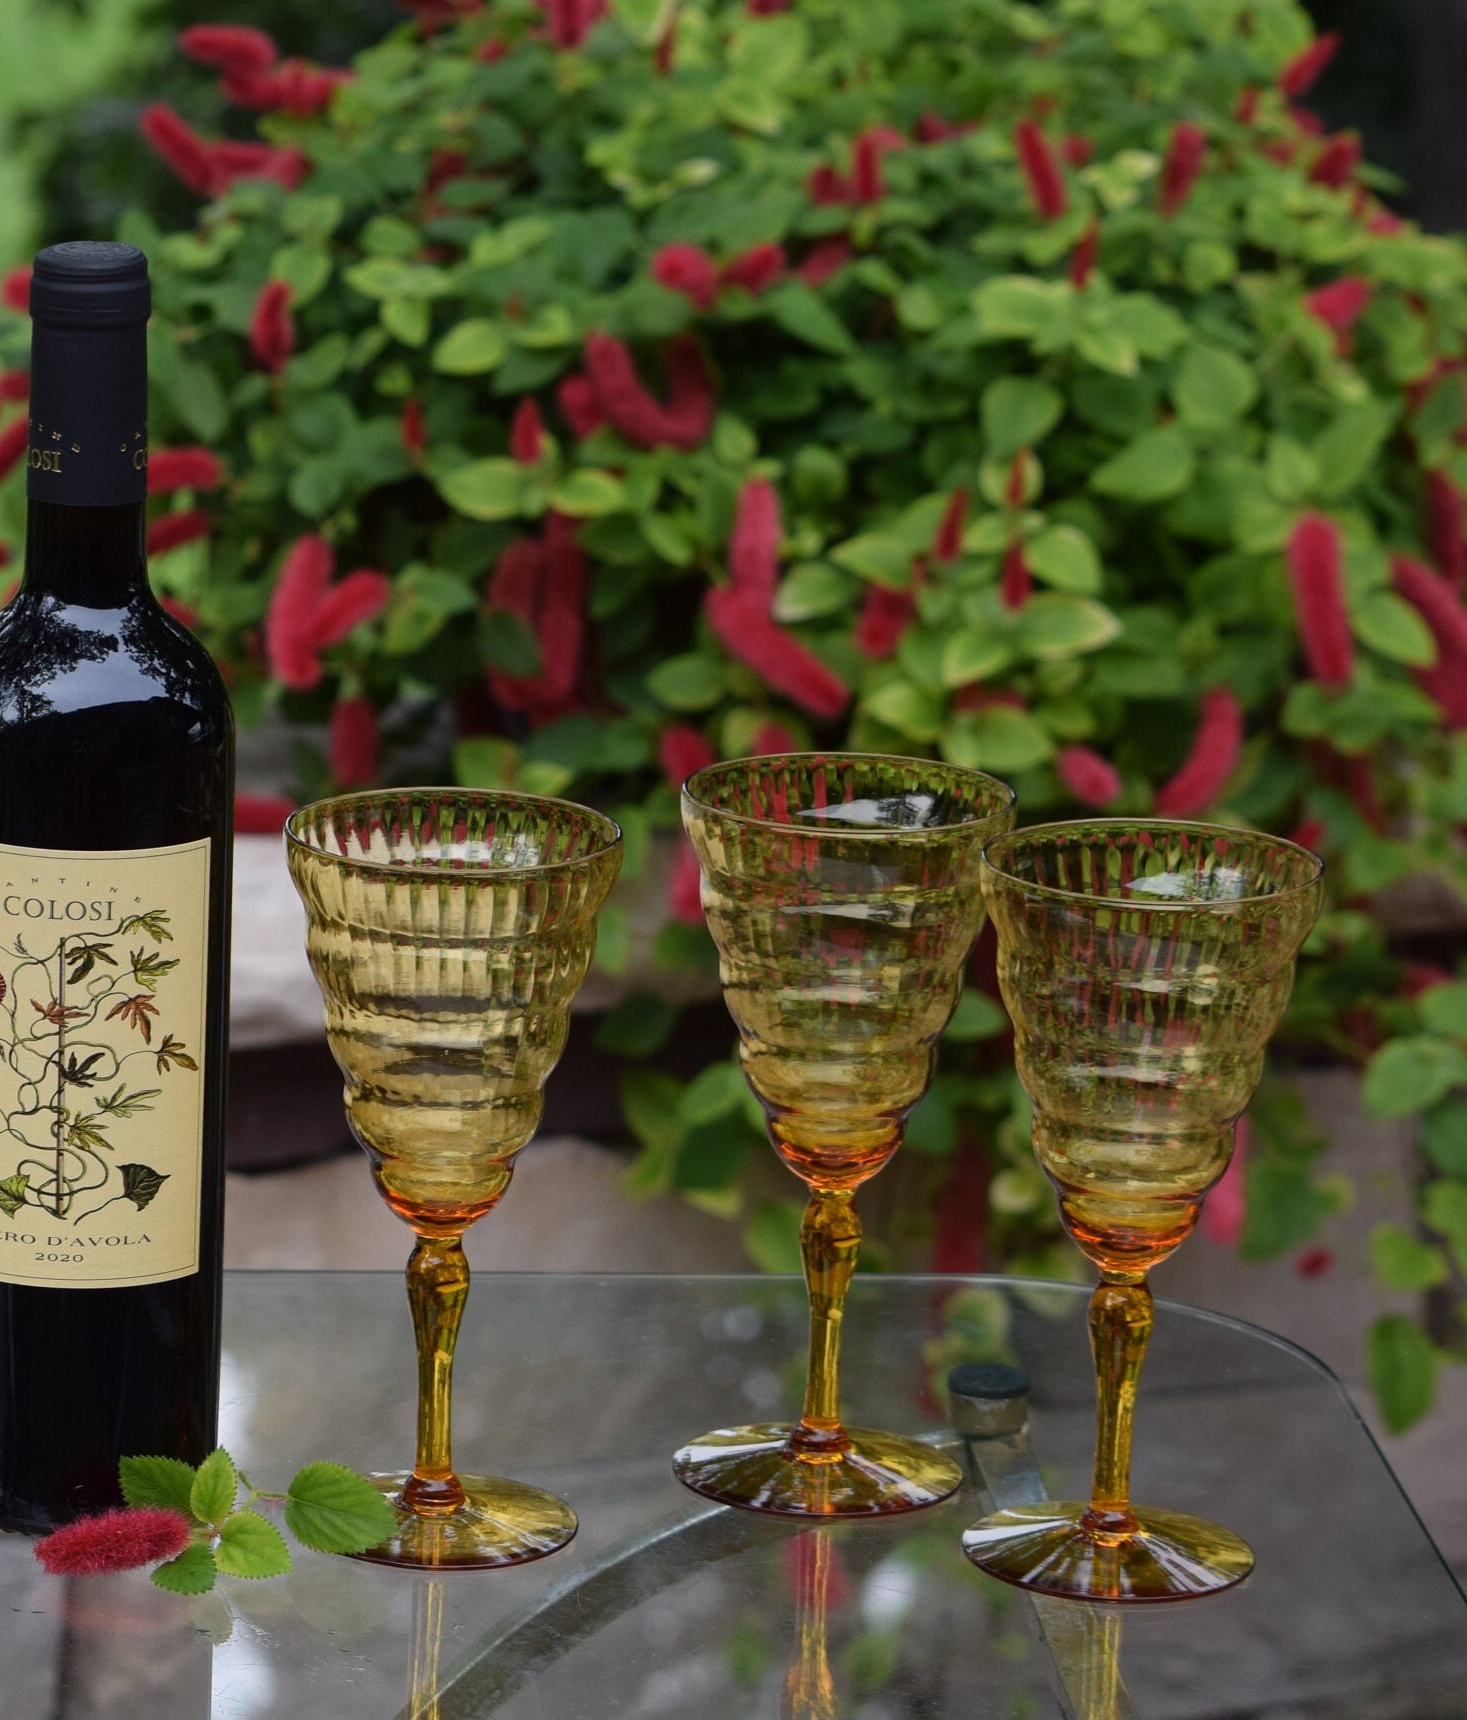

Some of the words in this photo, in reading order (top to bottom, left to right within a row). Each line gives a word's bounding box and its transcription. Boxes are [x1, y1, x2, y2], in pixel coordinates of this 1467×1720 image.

[3, 895, 113, 921] COLOSI
[47, 1233, 152, 1247] D'AVOLA
[35, 1252, 84, 1263] 2020
